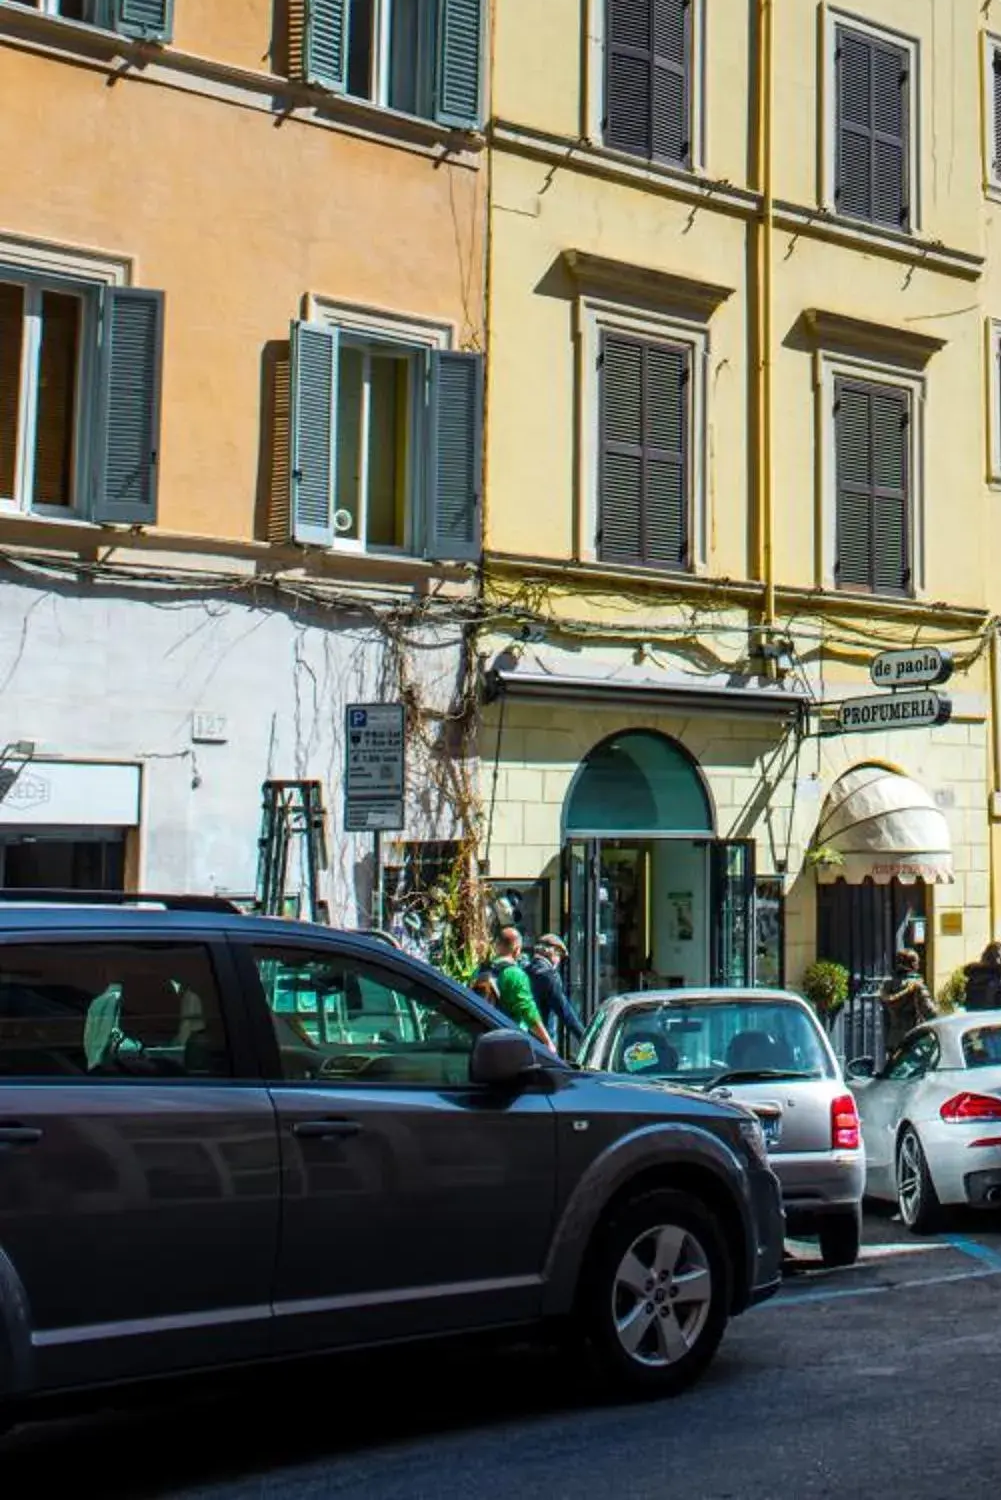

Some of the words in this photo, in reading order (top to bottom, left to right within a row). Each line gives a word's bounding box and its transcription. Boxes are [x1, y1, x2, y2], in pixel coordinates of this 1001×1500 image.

[874, 660, 892, 677] de
[896, 654, 937, 679] paola
[843, 699, 935, 725] PROFUMERIA
